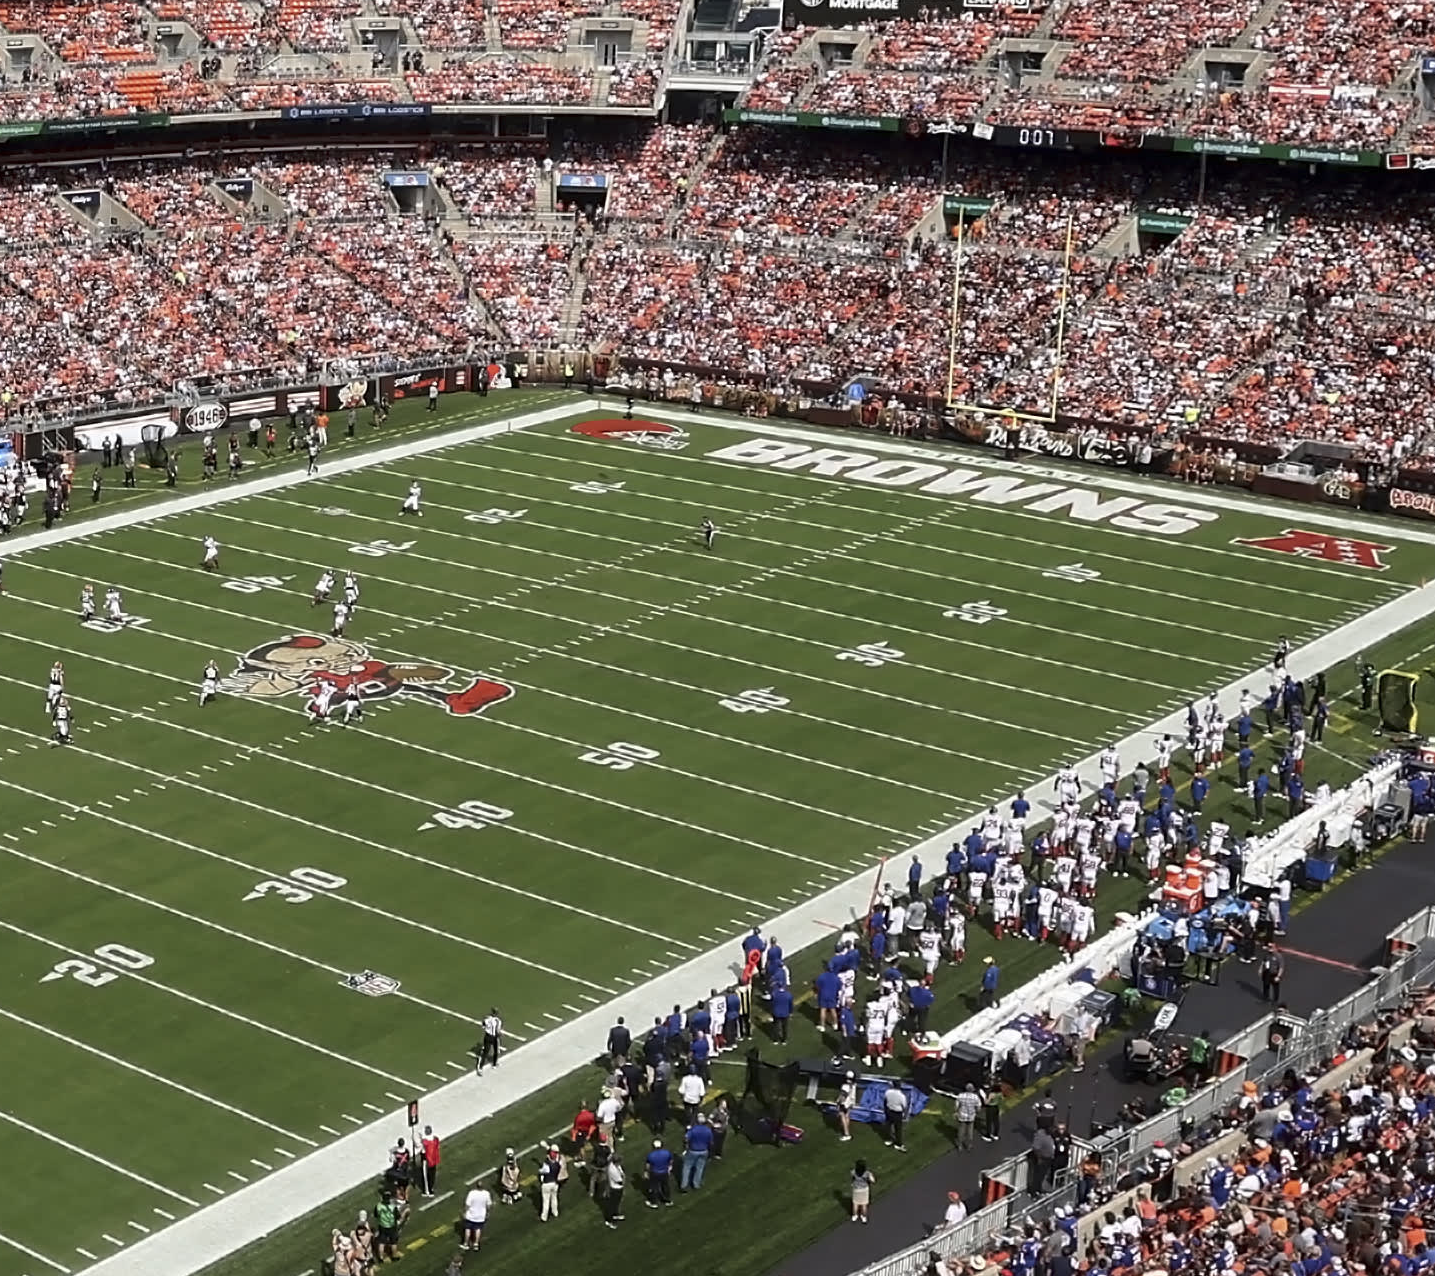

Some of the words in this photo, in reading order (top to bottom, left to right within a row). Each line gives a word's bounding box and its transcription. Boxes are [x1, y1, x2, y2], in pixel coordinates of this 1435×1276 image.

[1020, 130, 1054, 146] 0:07
[194, 408, 219, 426] 1946
[705, 437, 1221, 536] BROWNS
[578, 742, 660, 769] 50
[432, 800, 514, 829] 40
[255, 867, 348, 902] 30
[54, 944, 155, 987] 20
